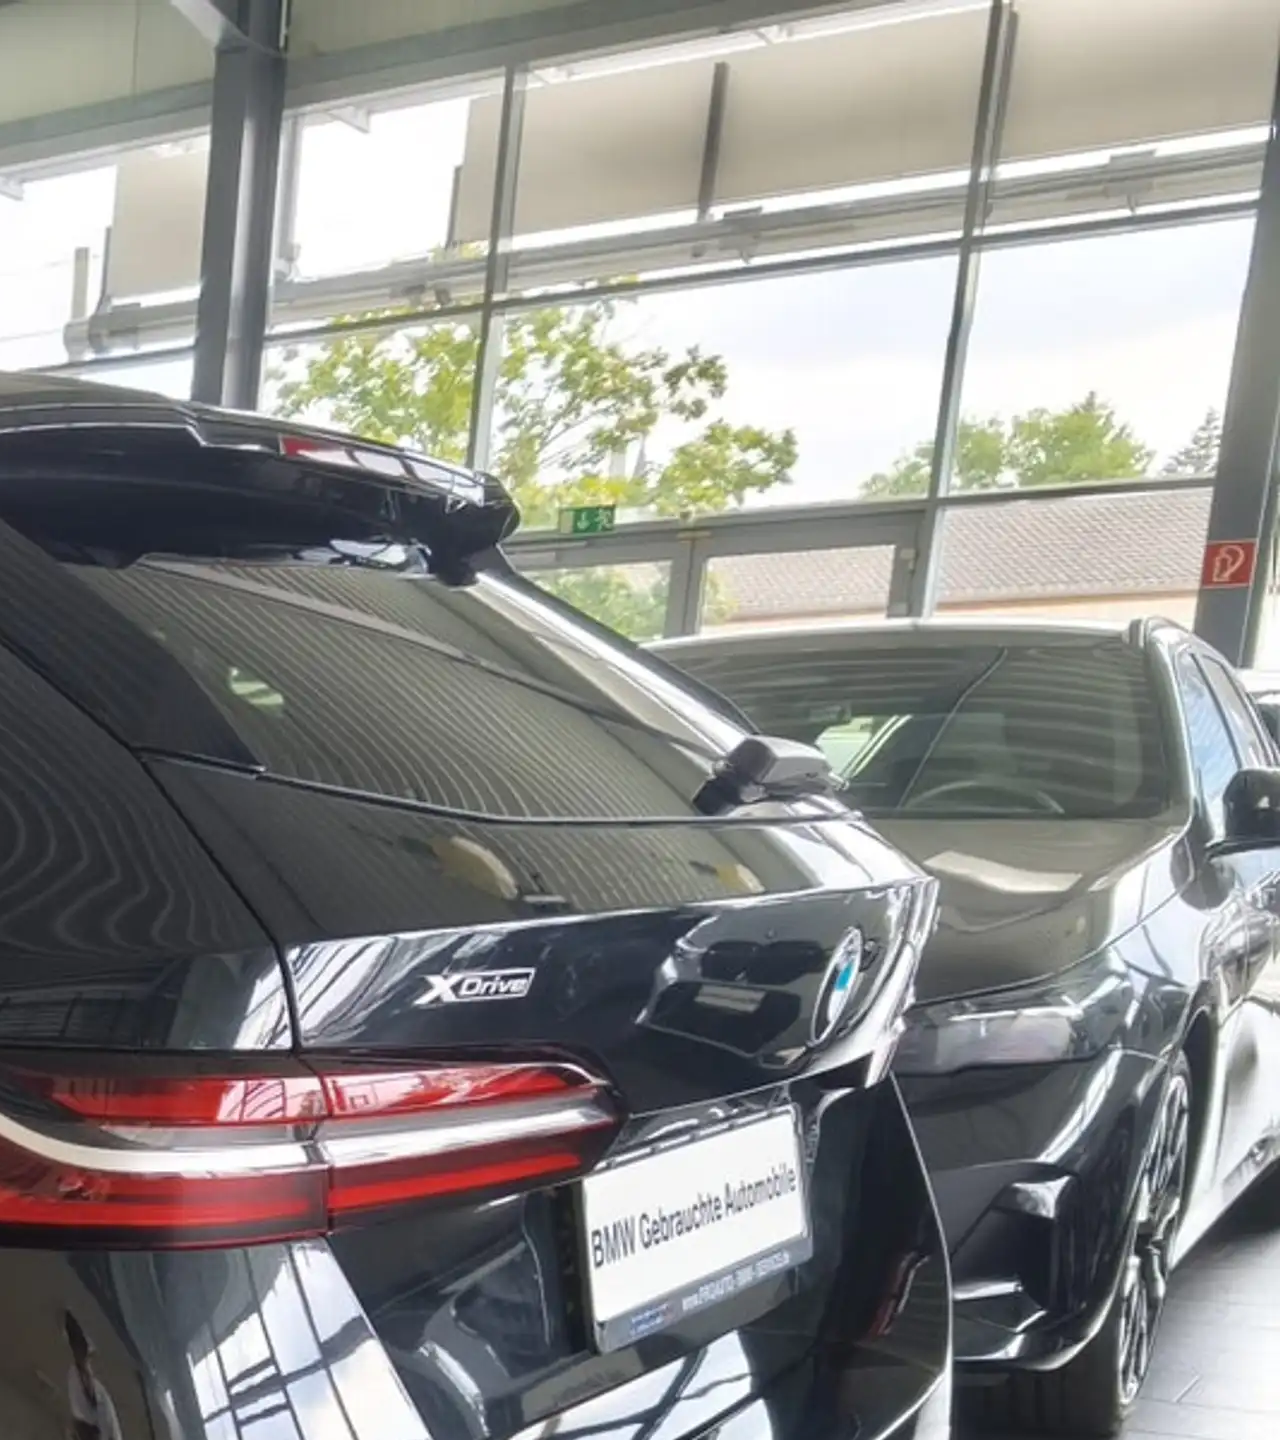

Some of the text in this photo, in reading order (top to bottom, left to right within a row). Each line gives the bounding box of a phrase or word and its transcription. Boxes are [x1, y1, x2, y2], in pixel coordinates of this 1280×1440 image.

[591, 1164, 797, 1268] BMW Gebrauchte Automobile
